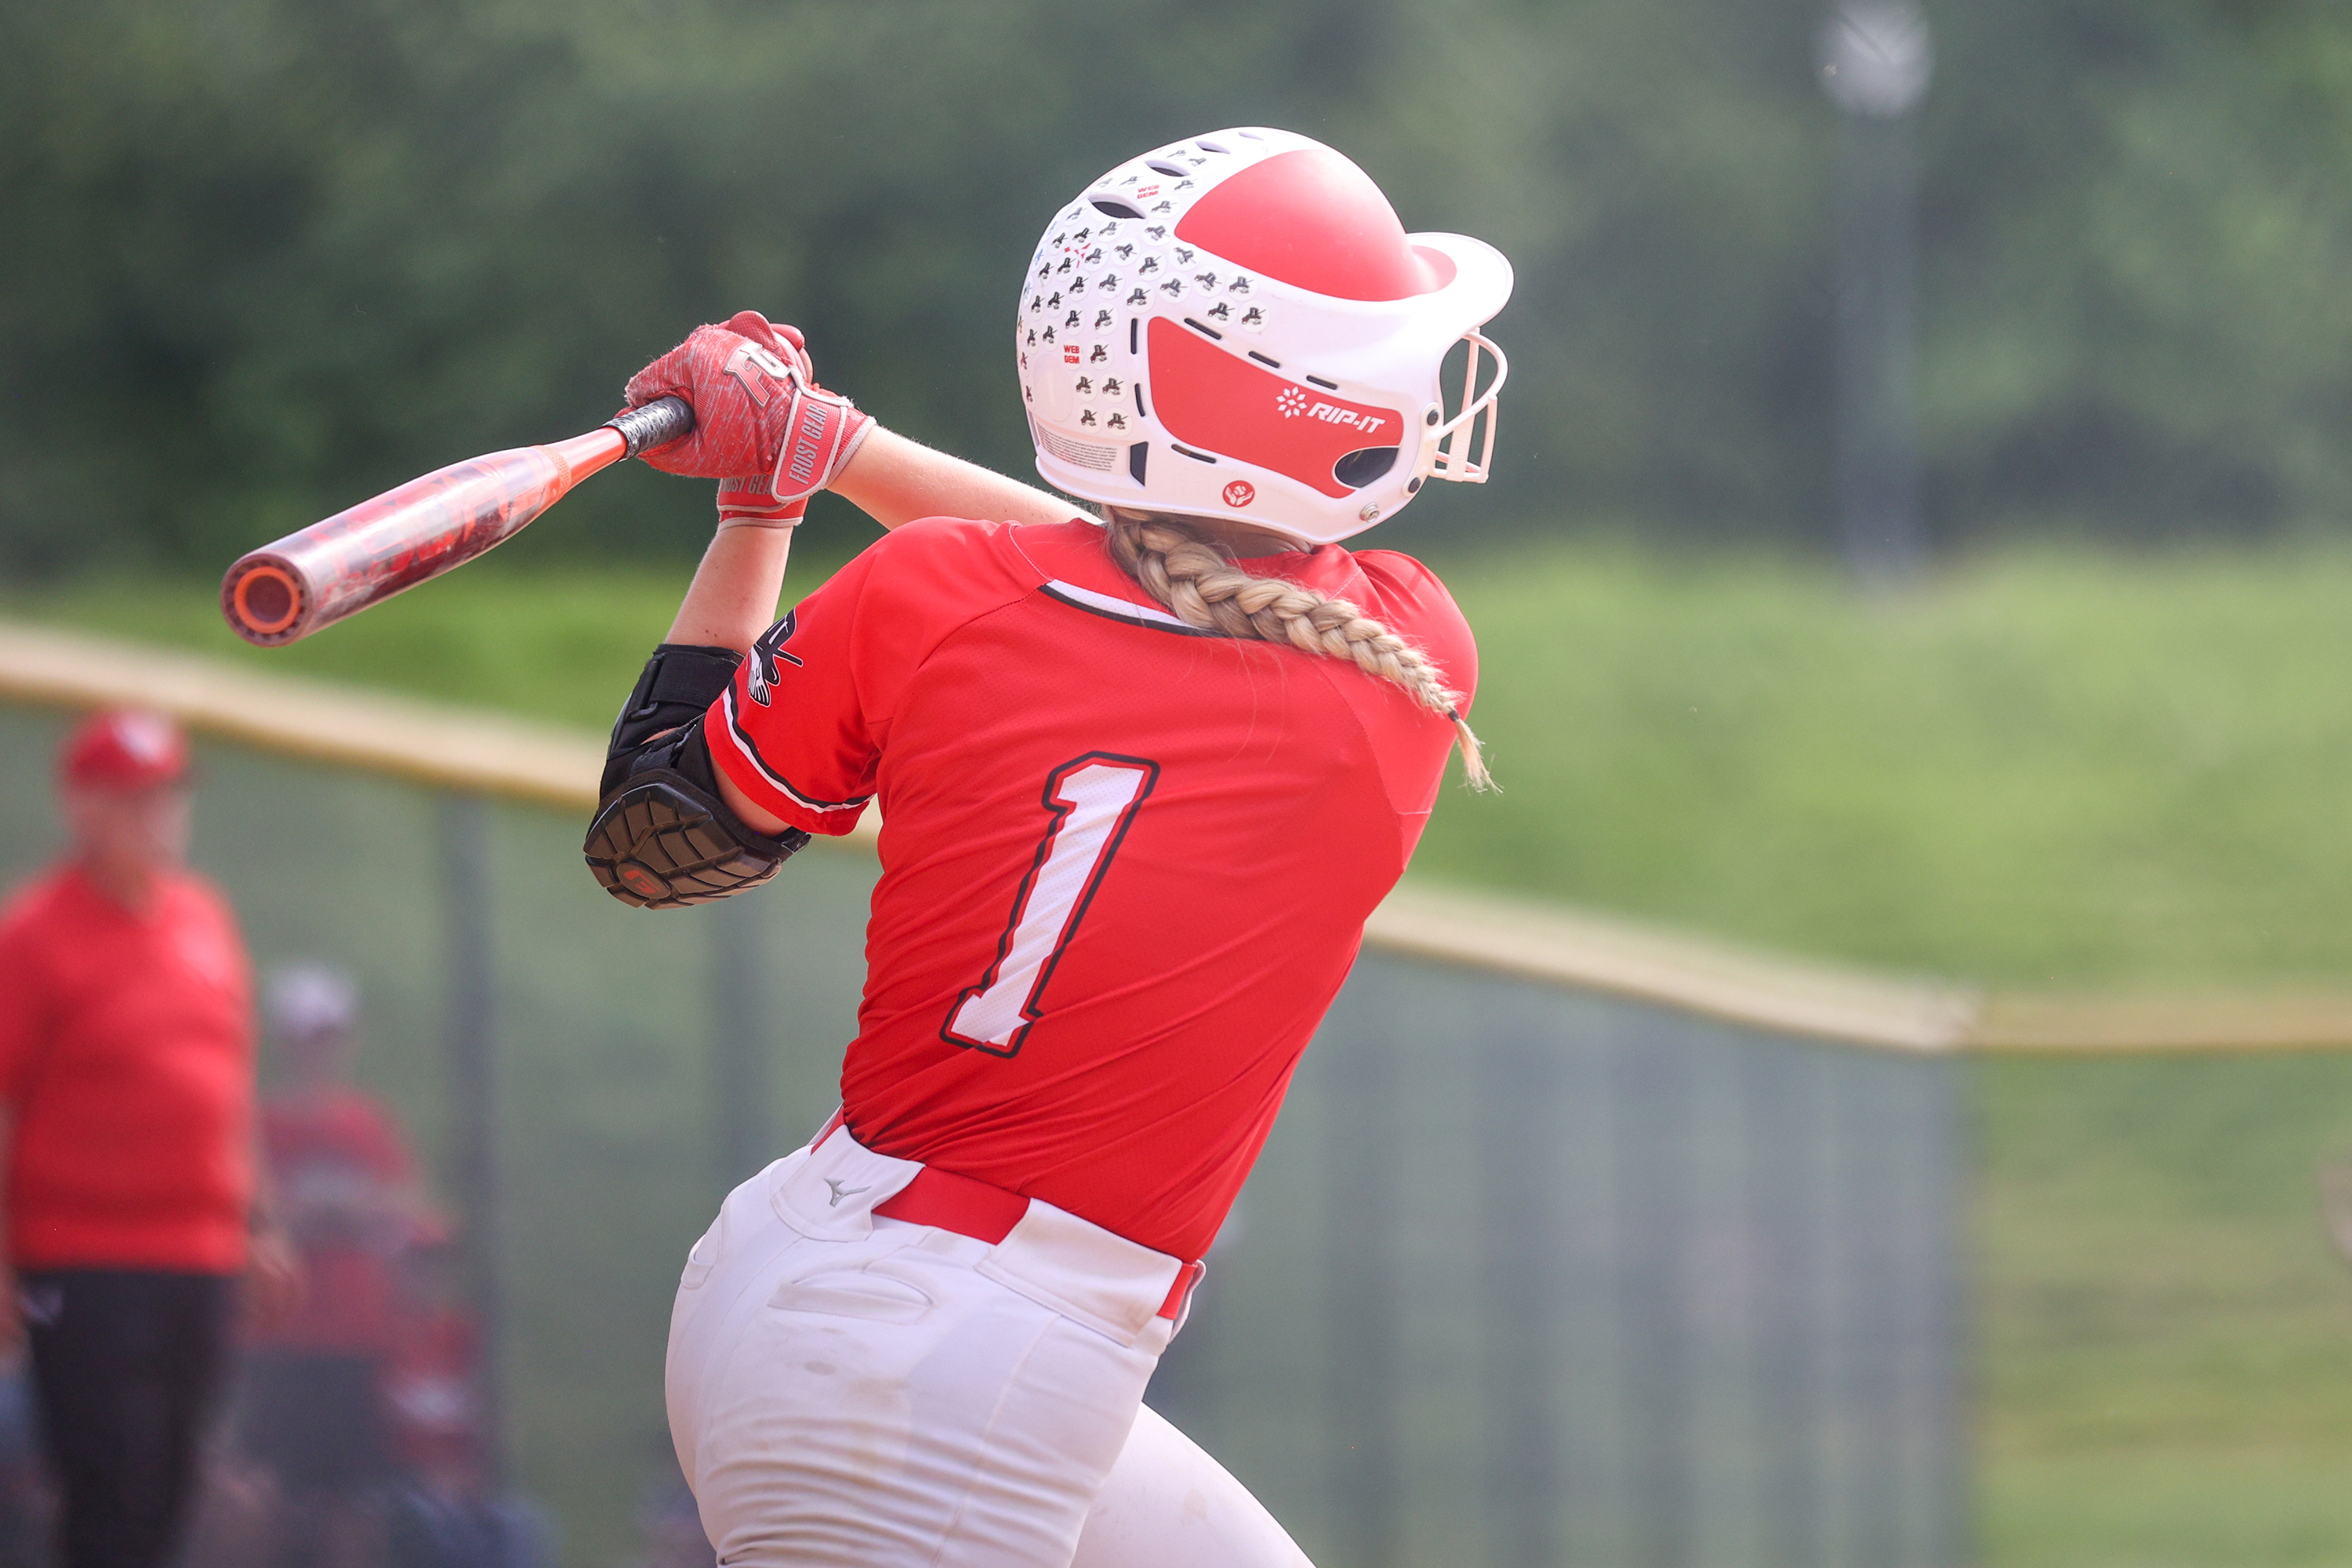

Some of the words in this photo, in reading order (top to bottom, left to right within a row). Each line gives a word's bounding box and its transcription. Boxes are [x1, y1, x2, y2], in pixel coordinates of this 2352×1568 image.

[1137, 191, 1159, 199] GEM
[1138, 184, 1160, 193] WEB
[1063, 345, 1080, 354] WEB
[1064, 354, 1080, 365] GEM
[801, 403, 827, 440] GEAR
[1308, 401, 1387, 434] RIP-IT
[789, 435, 818, 485] FROST
[748, 474, 774, 495] GEA
[939, 750, 1160, 1058] 1
